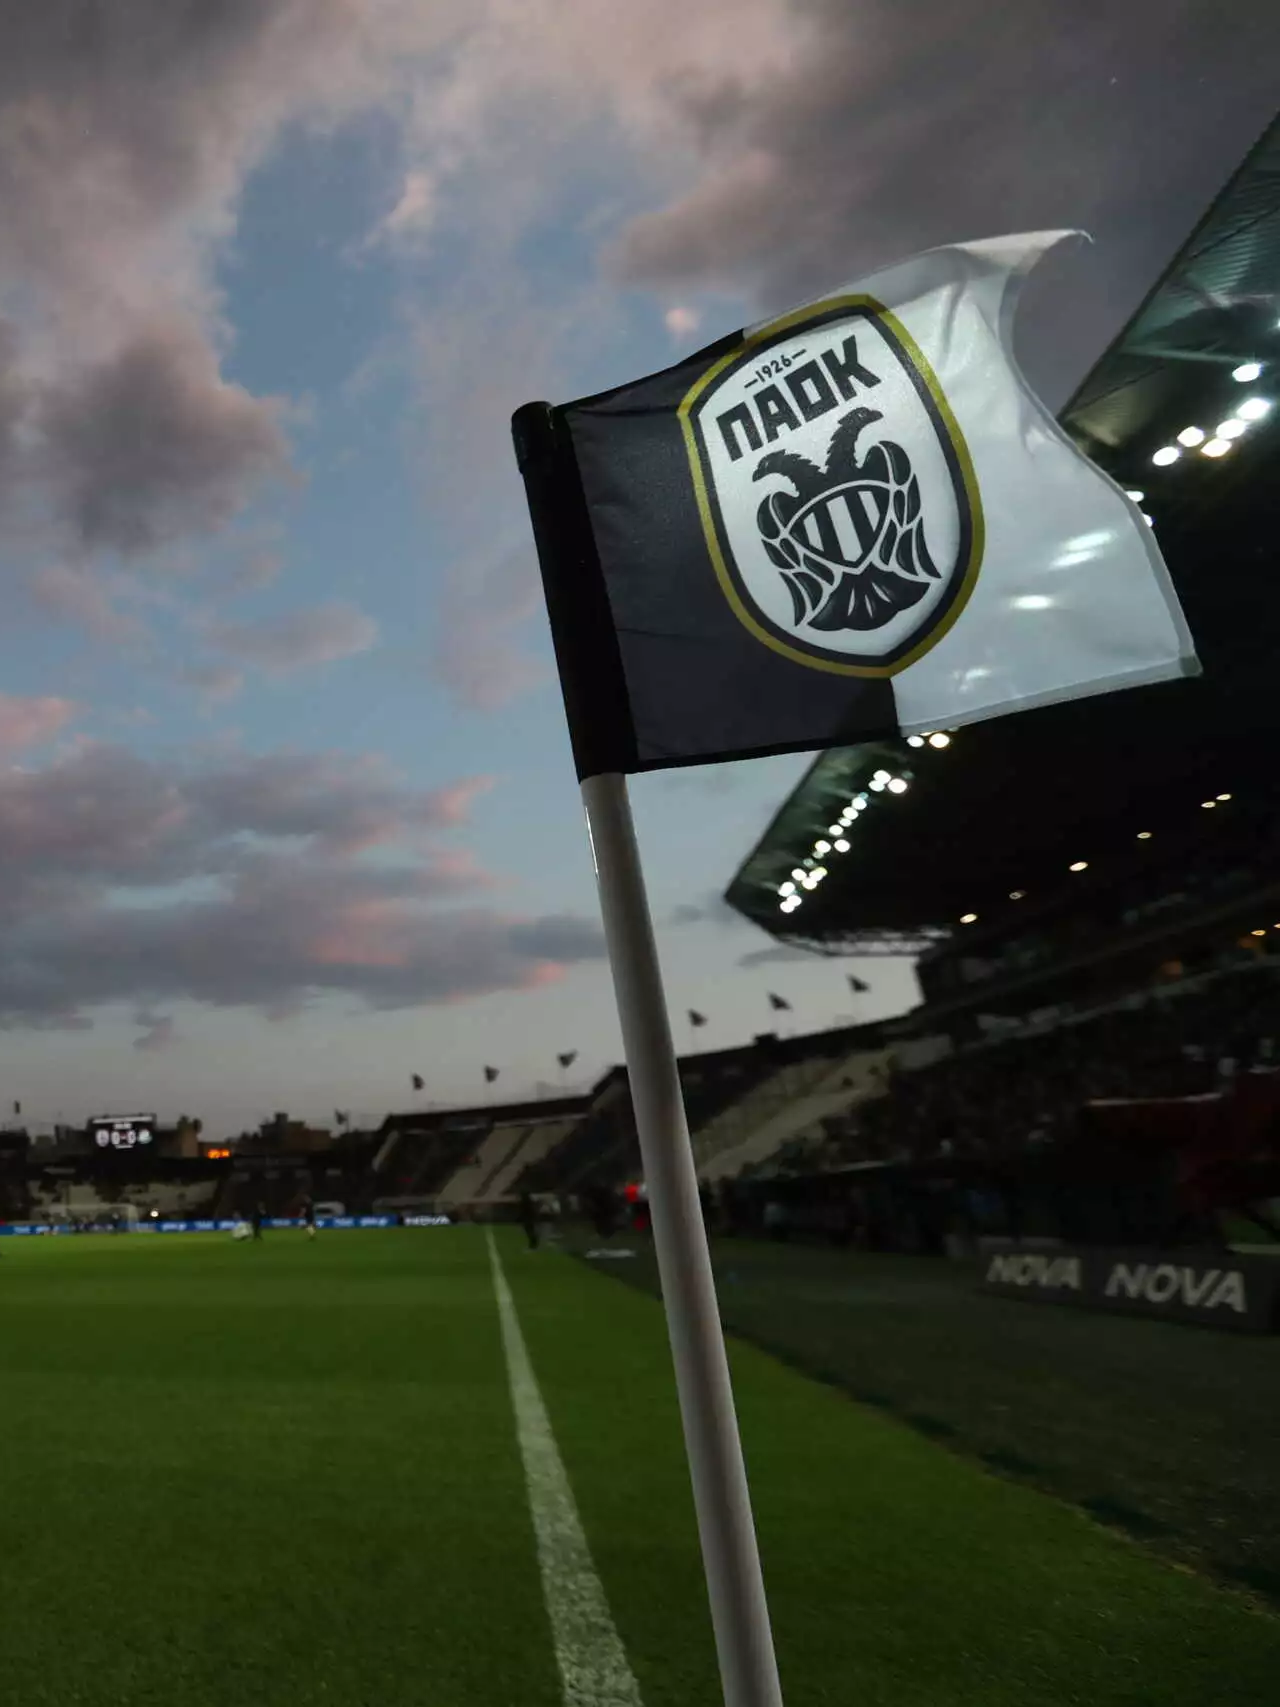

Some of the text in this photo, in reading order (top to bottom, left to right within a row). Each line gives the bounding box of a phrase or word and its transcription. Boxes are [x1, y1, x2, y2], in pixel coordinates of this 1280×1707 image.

[716, 335, 881, 462] ΠΑΟΚ
[986, 1255, 1082, 1290] NOVA
[1105, 1263, 1248, 1313] NOVA
